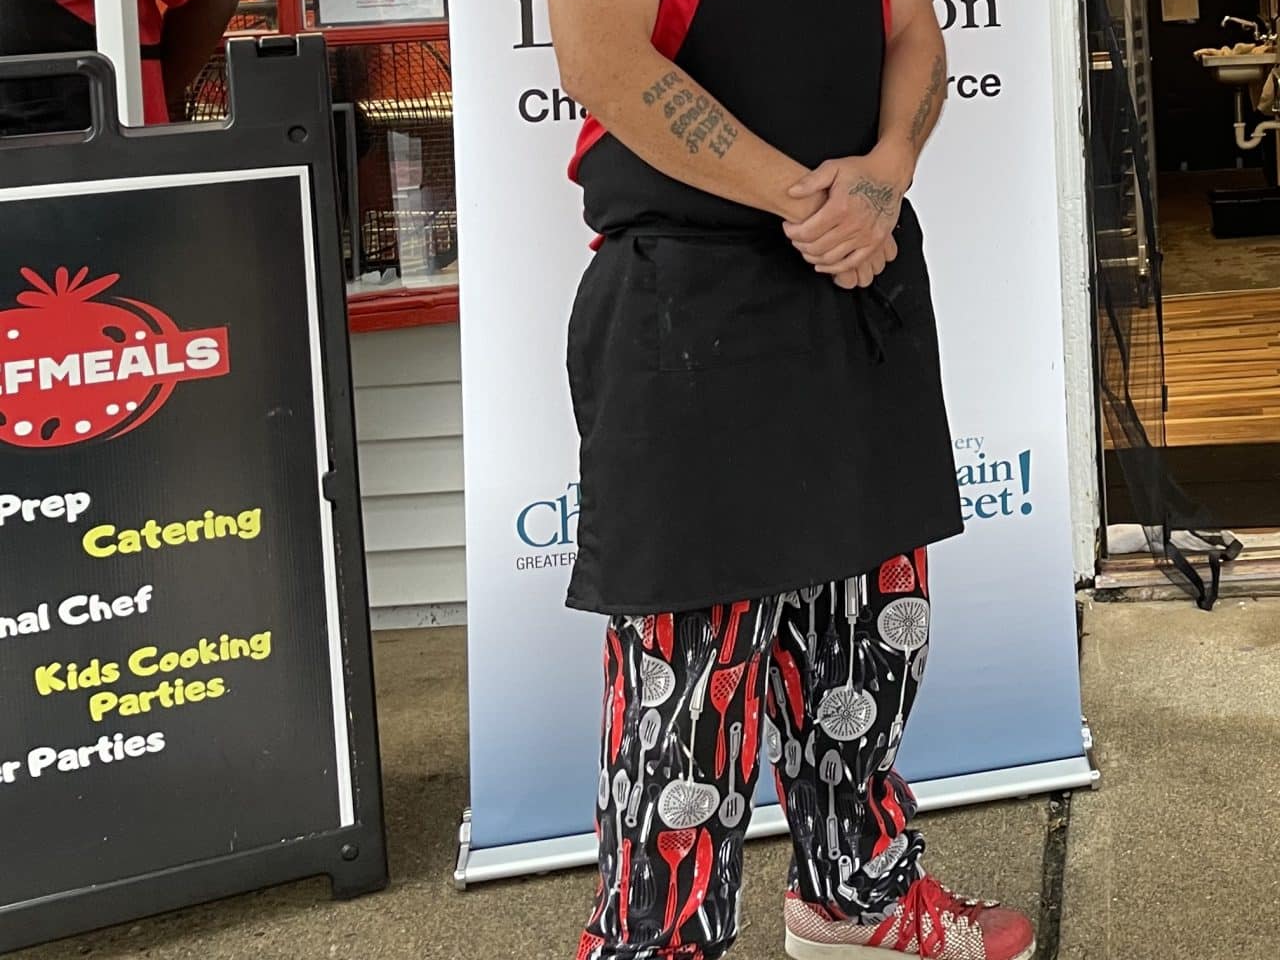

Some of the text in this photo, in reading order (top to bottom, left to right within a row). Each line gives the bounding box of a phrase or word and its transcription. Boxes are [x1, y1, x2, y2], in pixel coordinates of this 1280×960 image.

[518, 74, 1001, 123] Ch rce
[0, 337, 220, 396] FMEALS
[0, 492, 91, 526] Prep
[82, 507, 262, 558] Catering
[516, 551, 577, 570] GREATER
[58, 585, 153, 626] Chef
[35, 630, 272, 696] Kids Cooking
[88, 675, 225, 723] Parties
[28, 731, 166, 778] Parties
